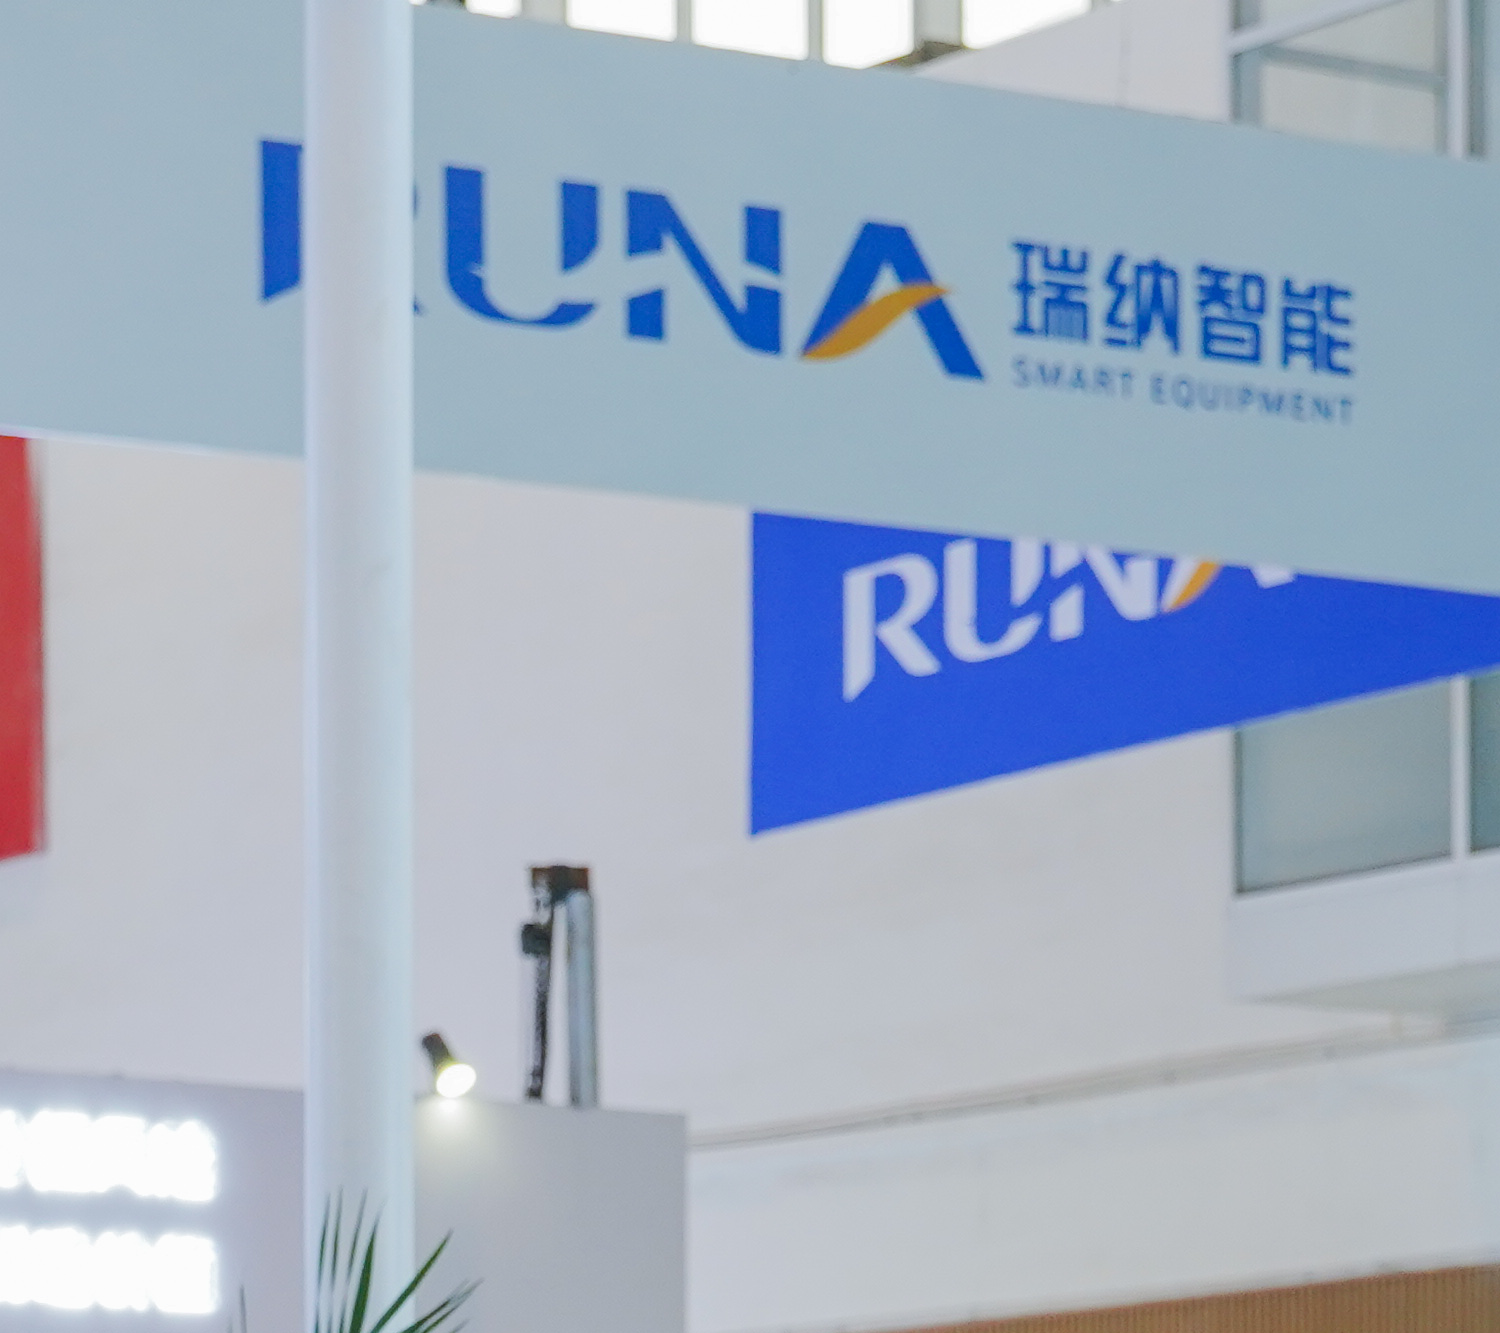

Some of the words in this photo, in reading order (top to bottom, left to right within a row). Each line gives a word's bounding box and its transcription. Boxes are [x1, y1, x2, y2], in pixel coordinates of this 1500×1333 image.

[1011, 236, 1355, 378] 瑞纳智能
[1012, 355, 1136, 402] SMART
[1150, 370, 1355, 424] EQUIPMENT
[843, 536, 1295, 703] RUN
